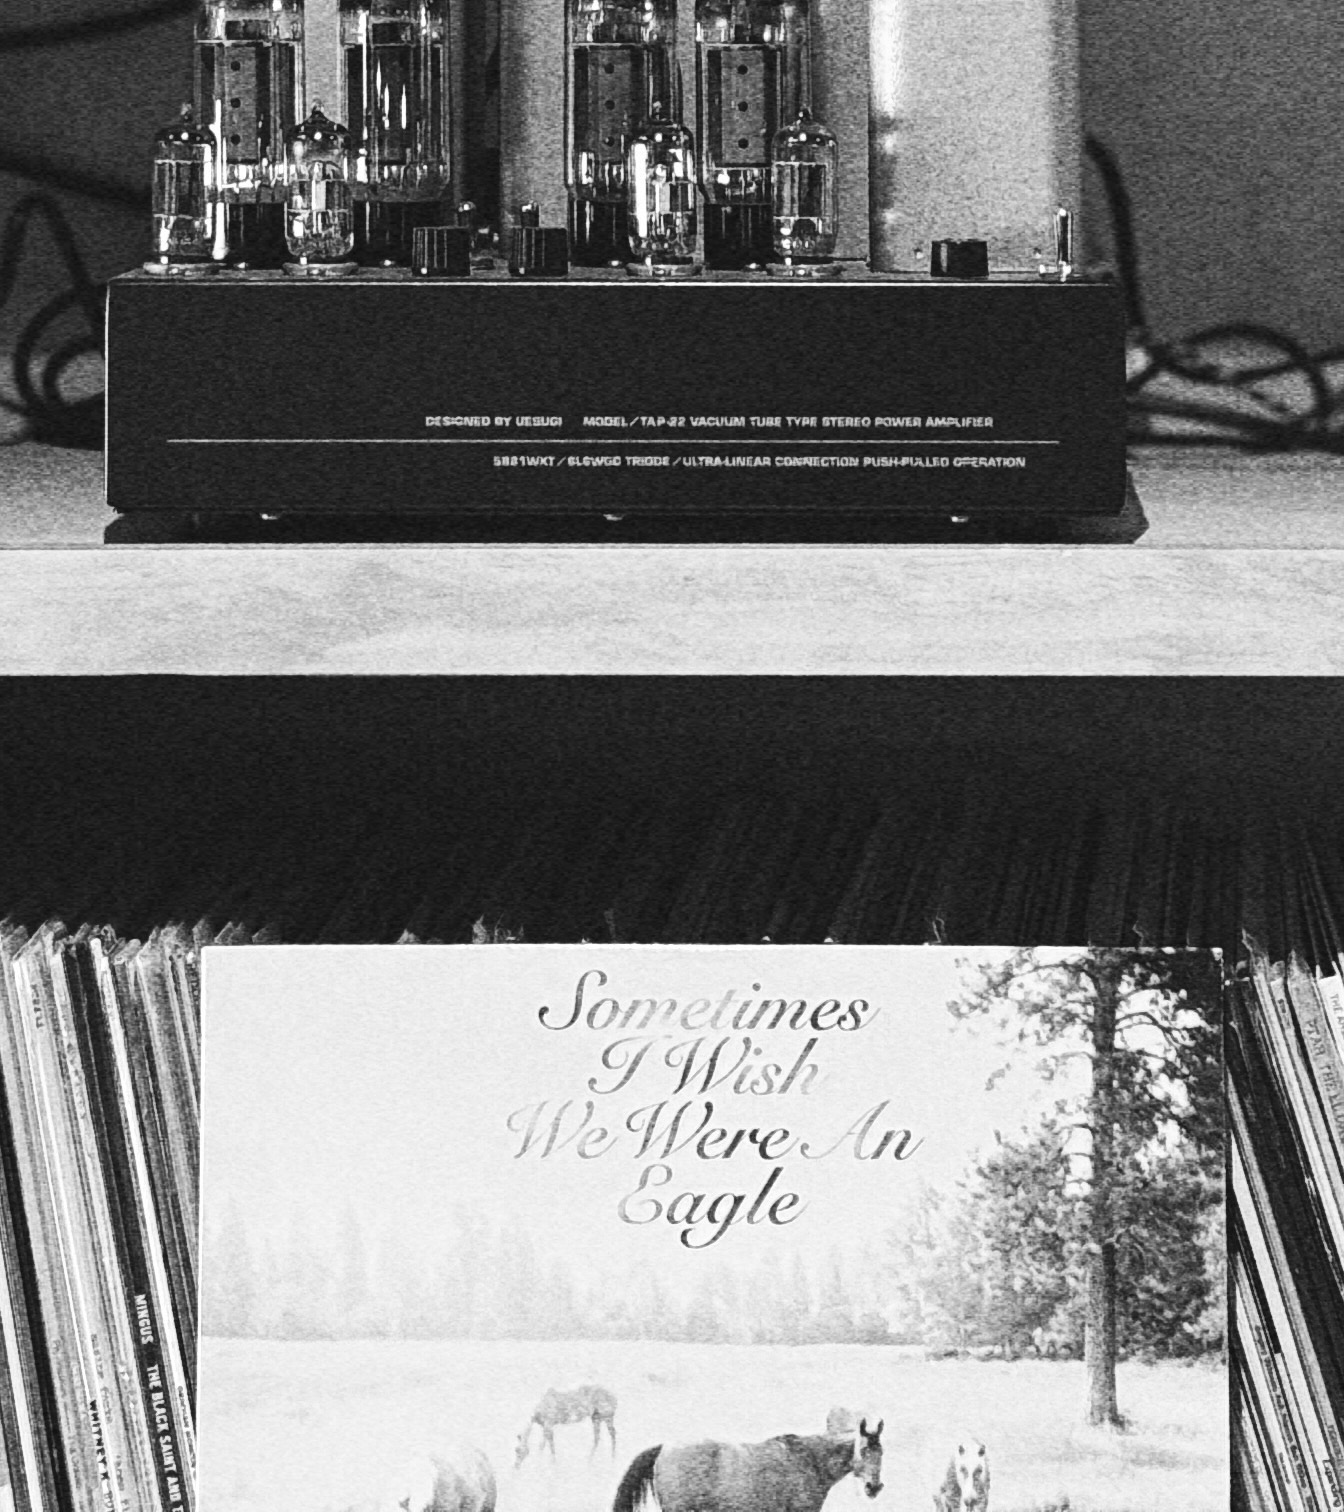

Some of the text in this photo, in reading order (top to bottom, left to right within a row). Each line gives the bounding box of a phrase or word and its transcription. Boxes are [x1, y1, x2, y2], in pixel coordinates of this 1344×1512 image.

[425, 416, 563, 427] DESIGNED BY UESUGI
[690, 416, 746, 428] VACUUM
[749, 416, 782, 428] TUBE
[786, 416, 818, 428] TYPE
[822, 416, 871, 428] STEREO
[874, 416, 922, 428] POWER
[925, 416, 994, 428] AMPLIFIER
[774, 456, 859, 468] CONNECTION
[952, 456, 1026, 468] OPERATION
[538, 969, 882, 1032] Sometimes
[1327, 993, 1343, 1013] THE
[587, 1034, 829, 1096] I Wish
[1303, 1019, 1327, 1058] PTAH
[1317, 1063, 1338, 1093] THE
[506, 1099, 925, 1161] We Were An
[616, 1163, 812, 1250] Eagle
[133, 1293, 182, 1502] MINGUS THE BLACK SAINT AND
[87, 1398, 107, 1468] WHITNEY
